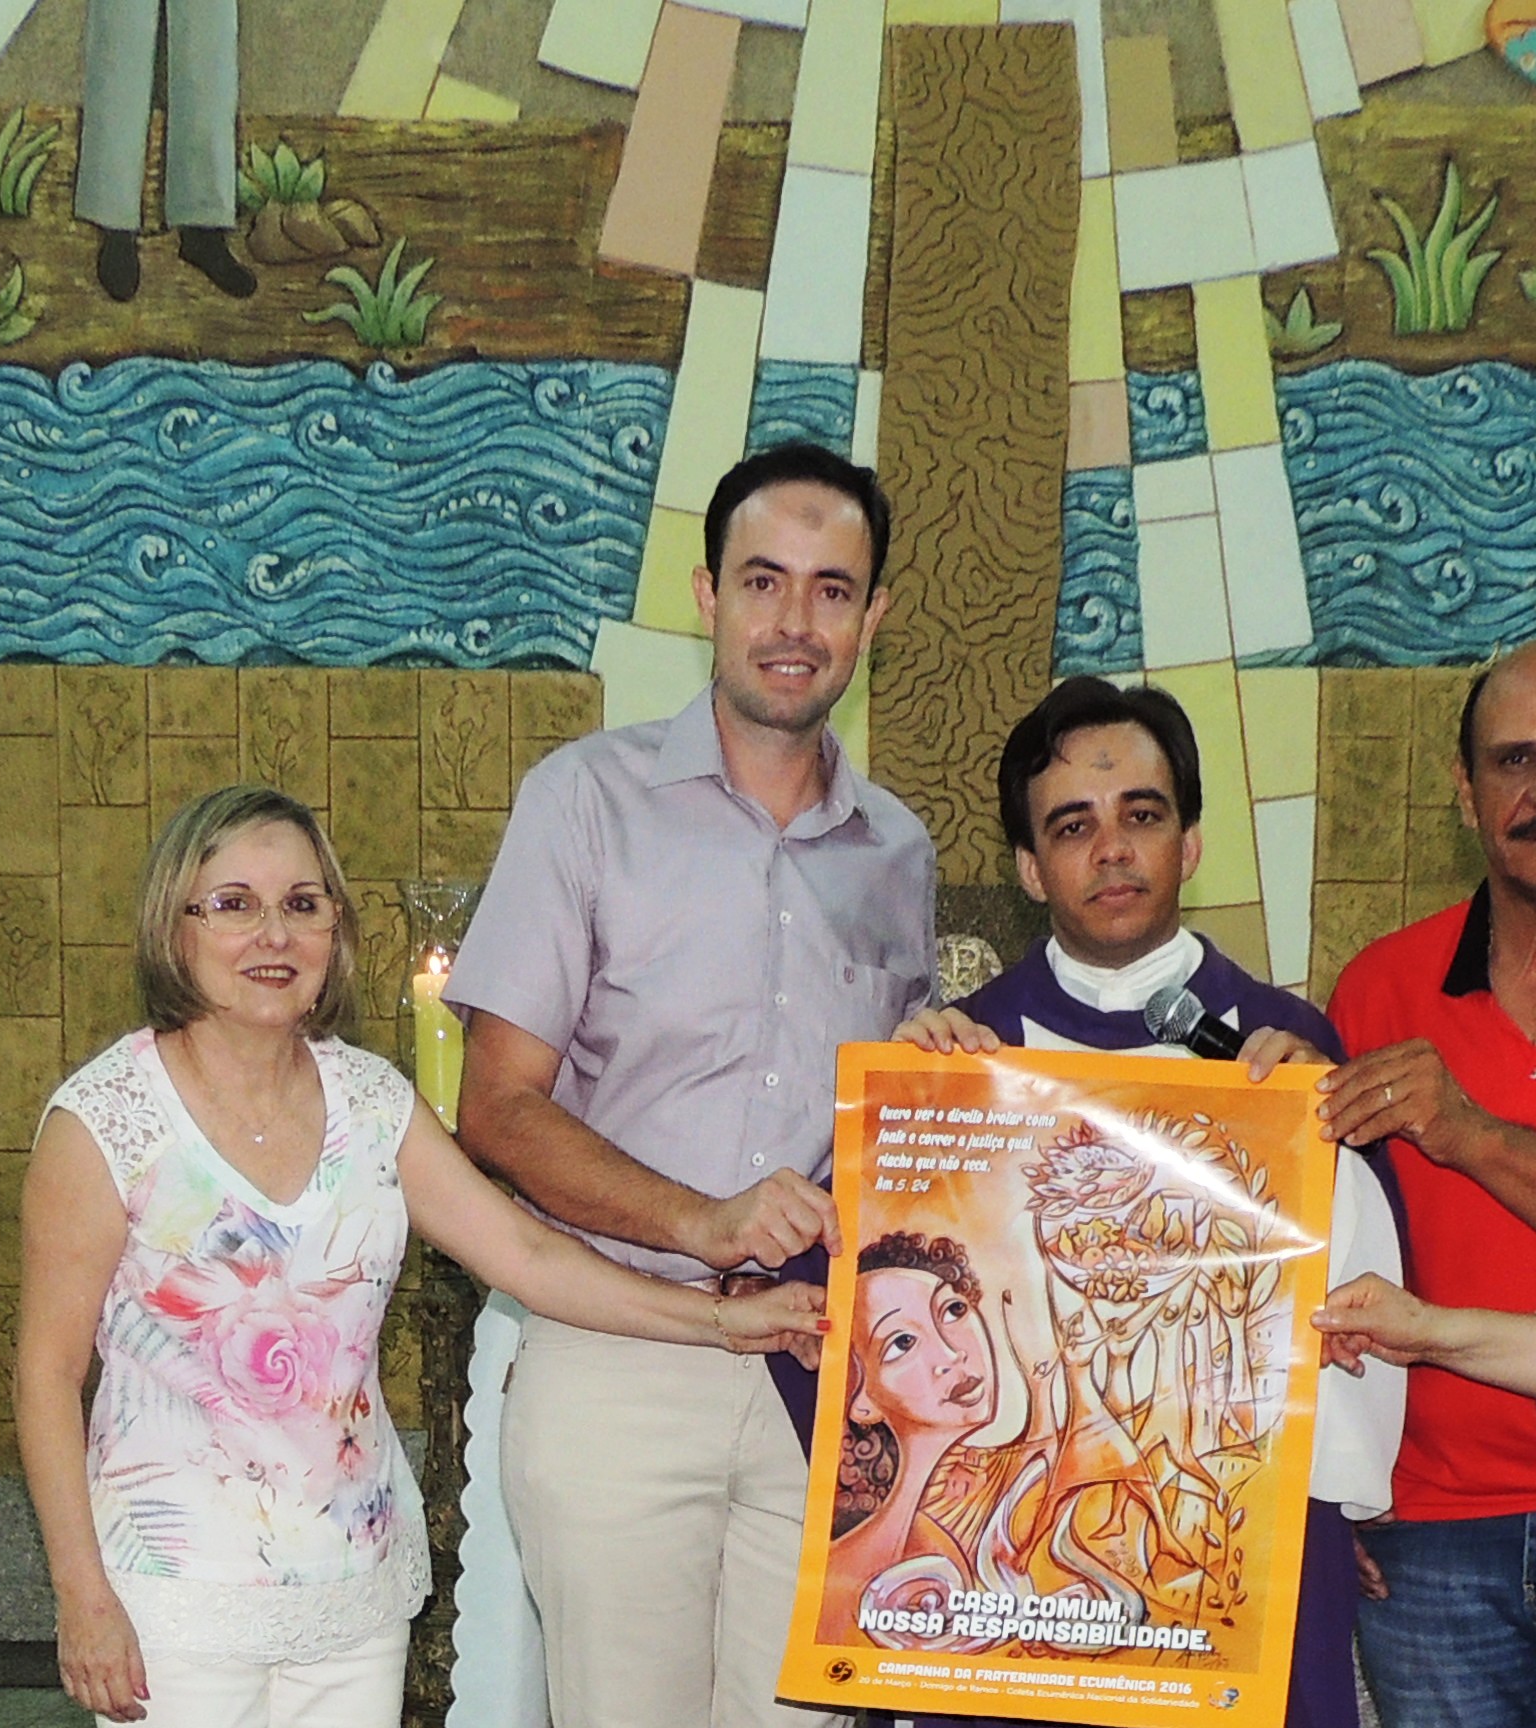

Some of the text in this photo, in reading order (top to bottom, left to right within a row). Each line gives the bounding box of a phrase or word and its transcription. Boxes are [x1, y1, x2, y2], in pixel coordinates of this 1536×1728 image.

[879, 1105, 1056, 1127] Quero ver o direito brotar como
[878, 1128, 1034, 1152] fonte e correr a justiça qual
[876, 1153, 991, 1173] riacho que não seca.
[875, 1174, 893, 1192] Am
[947, 1589, 1127, 1624] CASA COMUM,
[858, 1608, 1213, 1652] NOSSA RESPONSABILIDADE.
[872, 1677, 883, 1686] de
[956, 1684, 967, 1692] de
[969, 1684, 999, 1694] Ramos
[1007, 1686, 1034, 1697] Coleta
[1036, 1688, 1085, 1700] Ecumênica
[1087, 1692, 1125, 1703] Nacional
[1127, 1694, 1138, 1704] da
[877, 1661, 1193, 1695] CAMPANHA DA FRATERNIDADE ECUMÊNICA 2016
